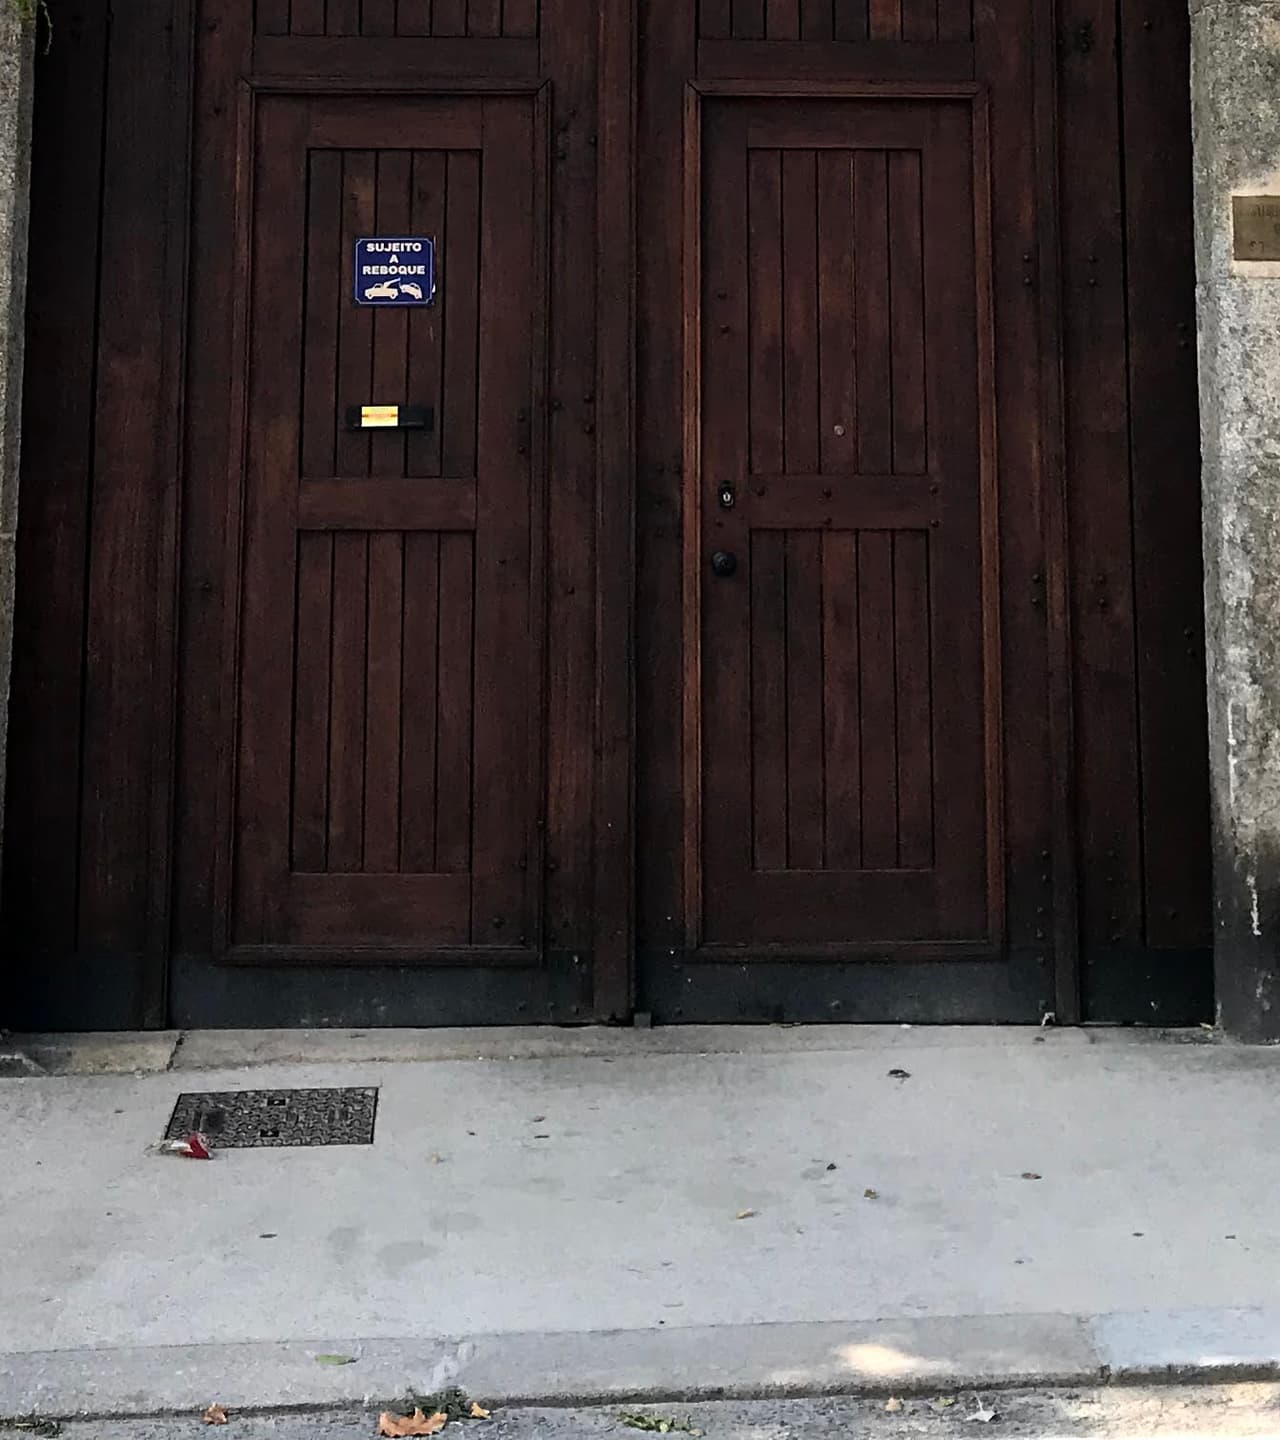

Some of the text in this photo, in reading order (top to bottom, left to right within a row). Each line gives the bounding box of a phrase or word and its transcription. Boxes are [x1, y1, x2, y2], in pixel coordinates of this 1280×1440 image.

[366, 242, 422, 252] SUJEITO
[389, 254, 399, 264] A
[362, 265, 426, 275] REBOQUE
